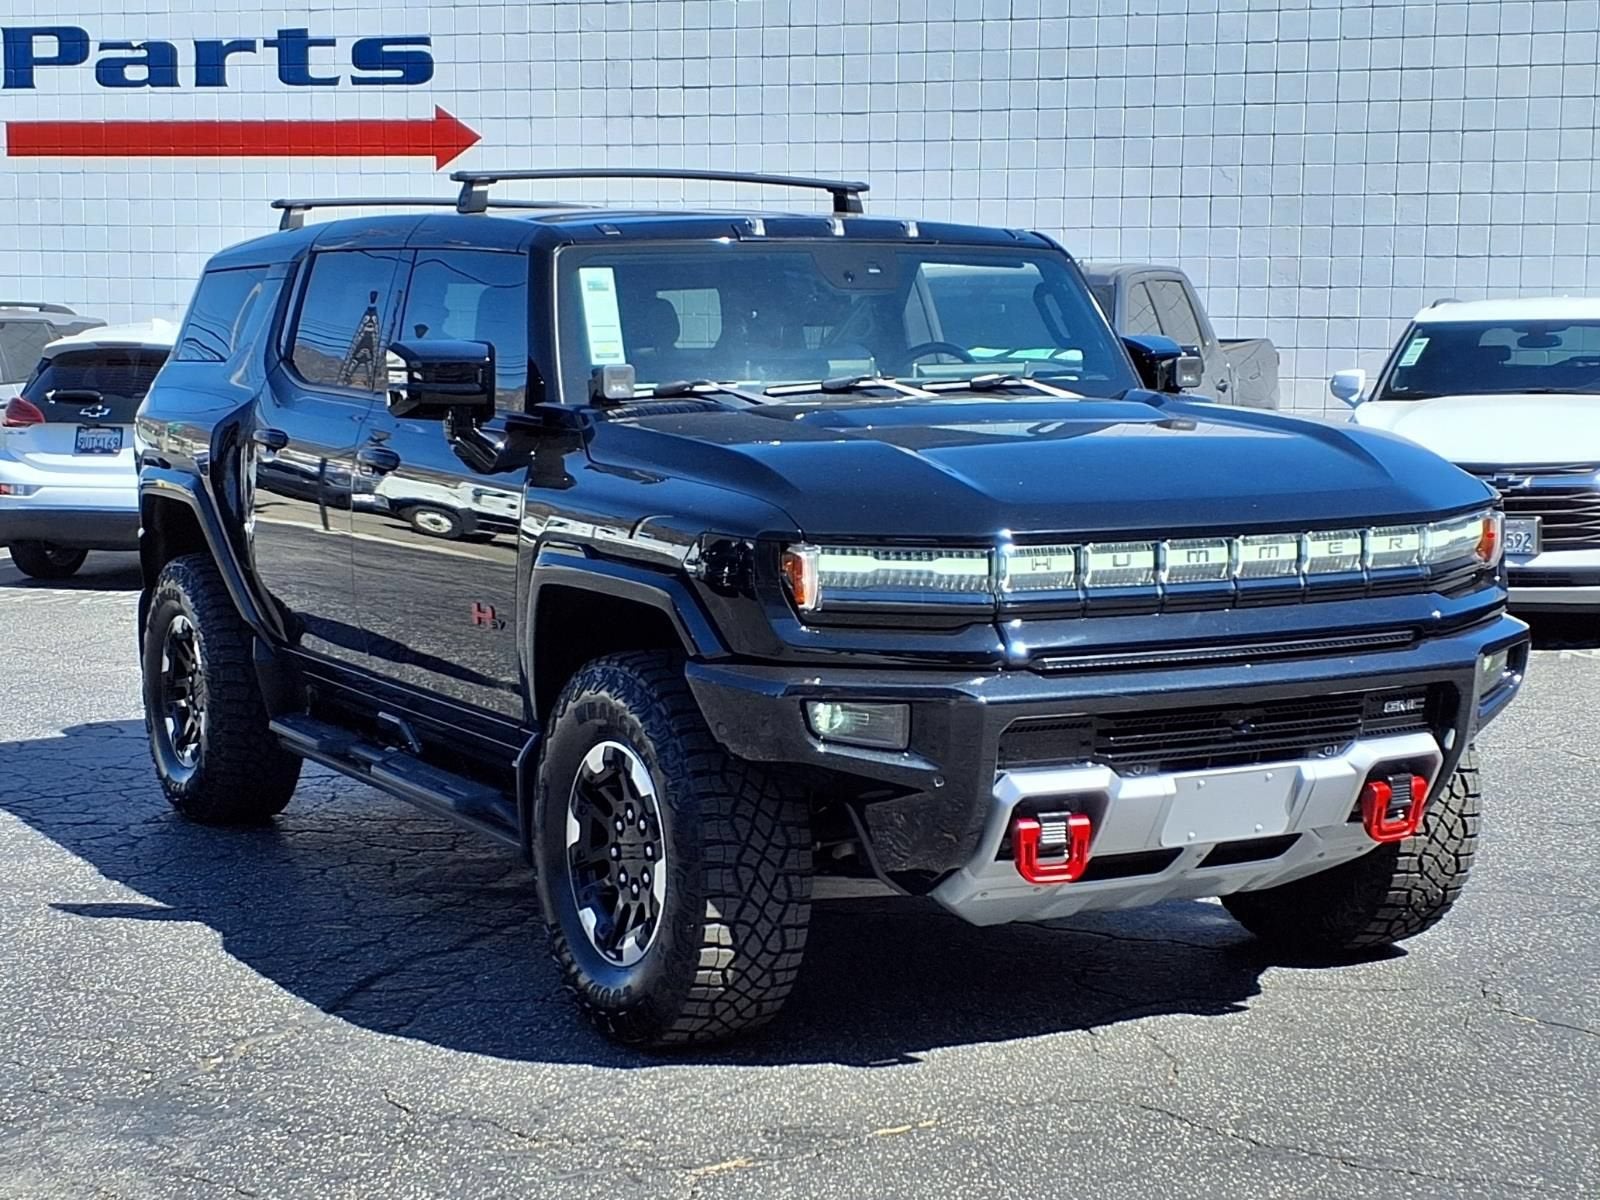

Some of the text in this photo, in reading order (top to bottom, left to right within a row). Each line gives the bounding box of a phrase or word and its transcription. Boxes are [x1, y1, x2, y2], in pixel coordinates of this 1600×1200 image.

[1, 26, 435, 89] Parts
[1031, 538, 1403, 571] HUMMER
[1383, 696, 1426, 714] GMC
